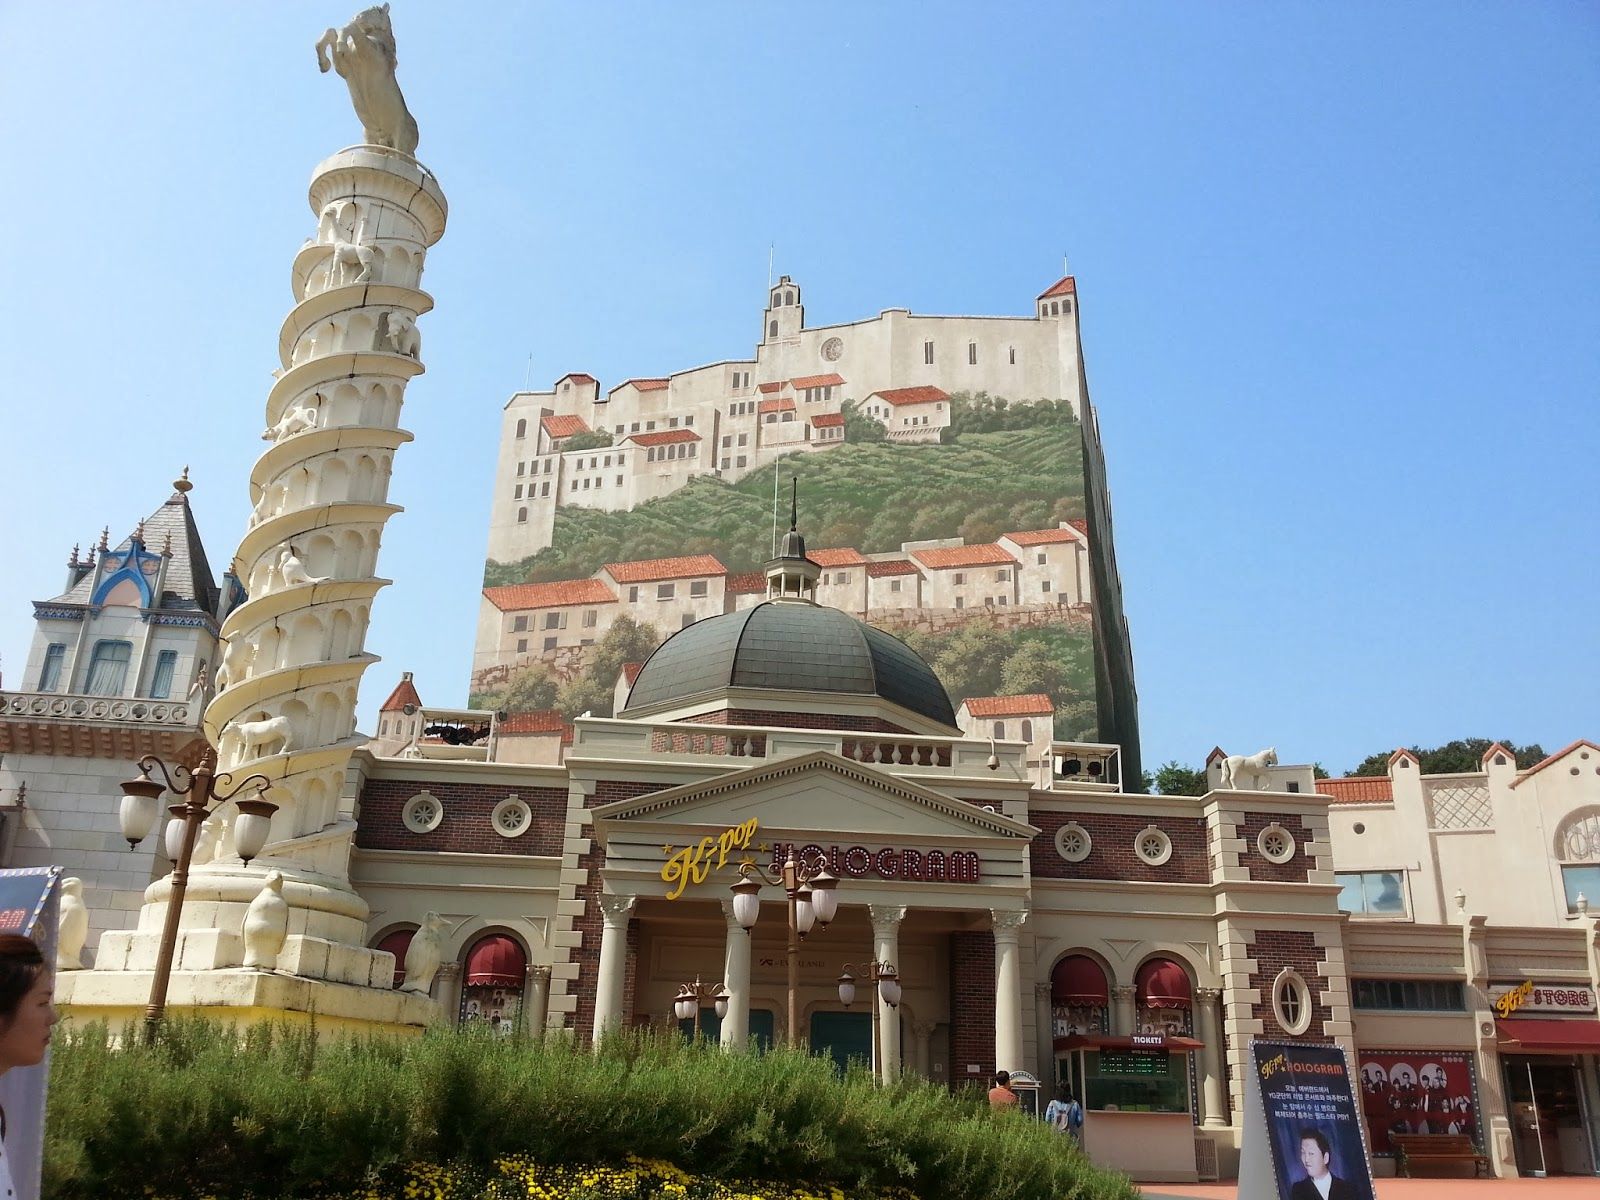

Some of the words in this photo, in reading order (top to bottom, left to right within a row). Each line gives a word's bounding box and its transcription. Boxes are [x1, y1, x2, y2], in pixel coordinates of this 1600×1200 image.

[661, 817, 758, 900] K-pop
[771, 842, 981, 883] HOLOGRAM
[1534, 989, 1589, 1006] STORE
[1132, 1036, 1162, 1045] TICKETS
[1286, 1062, 1344, 1076] HOLOGRAM
